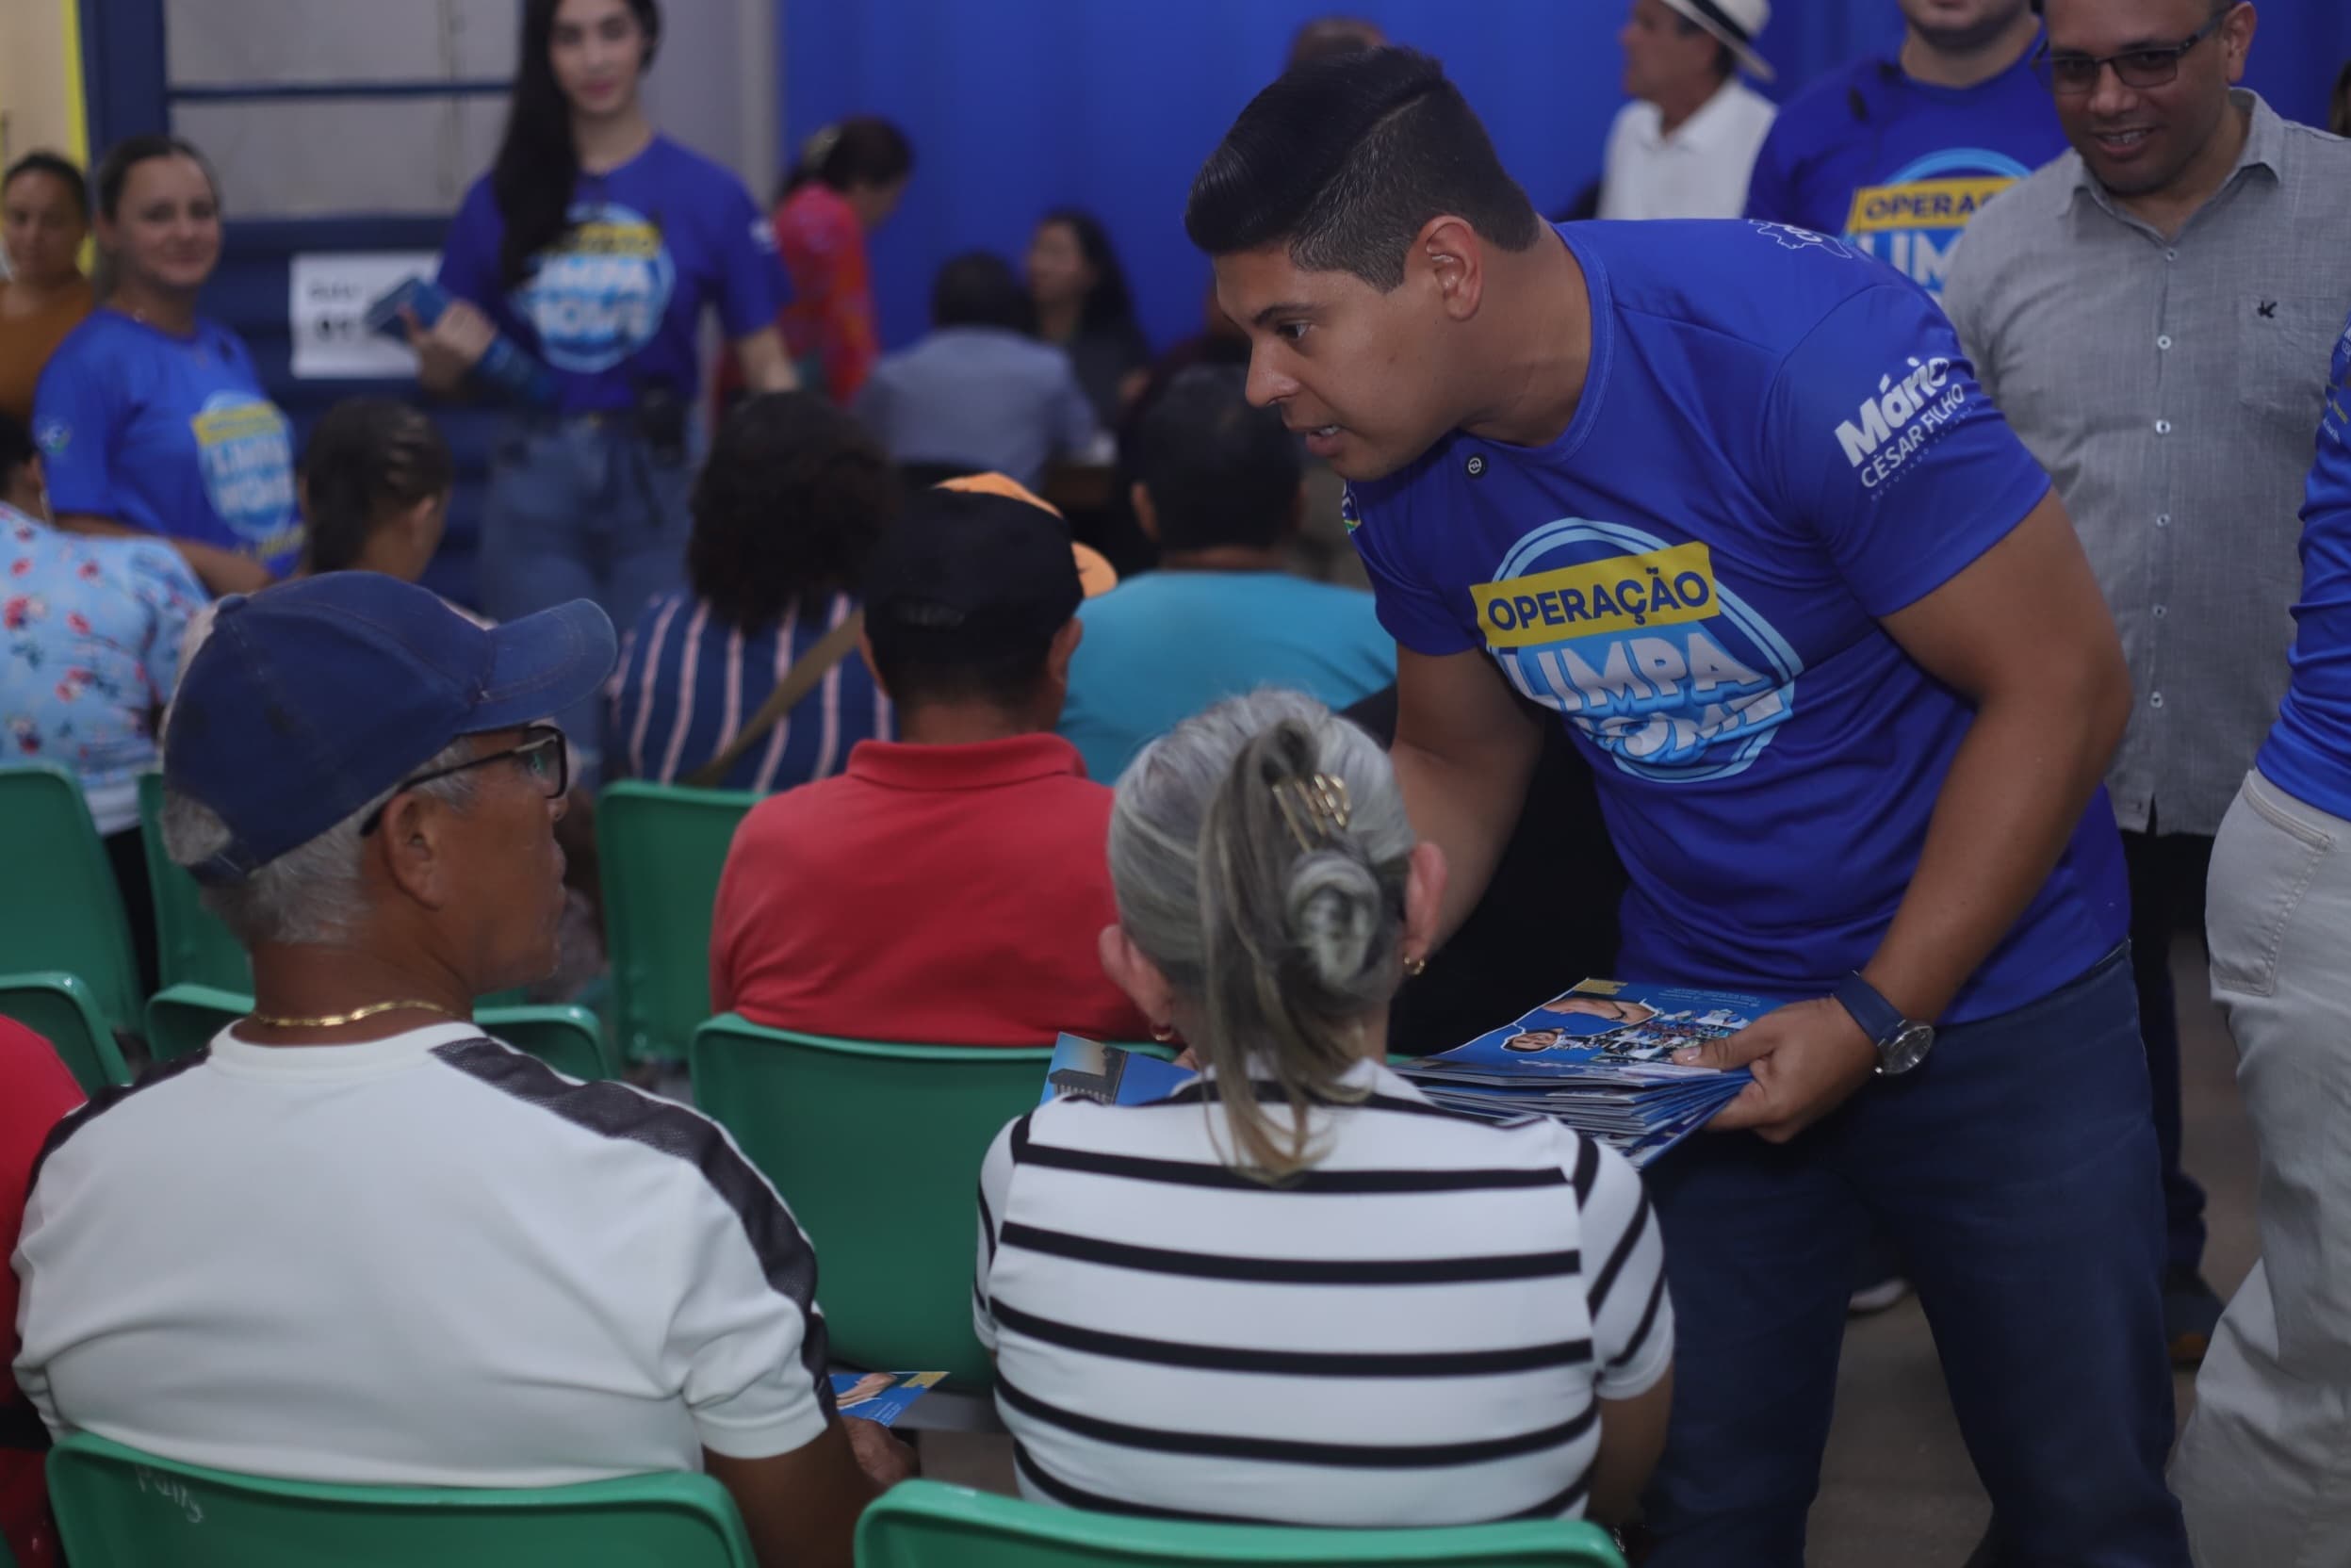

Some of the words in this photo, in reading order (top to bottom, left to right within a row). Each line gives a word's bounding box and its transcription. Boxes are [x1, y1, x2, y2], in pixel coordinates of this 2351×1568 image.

[1865, 190, 1994, 220] OPERA
[1835, 357, 1950, 468] Mário
[1919, 383, 1966, 433] FILHO
[1487, 567, 1710, 631] OPERAÇÃO
[1502, 632, 1764, 712] LIMPA
